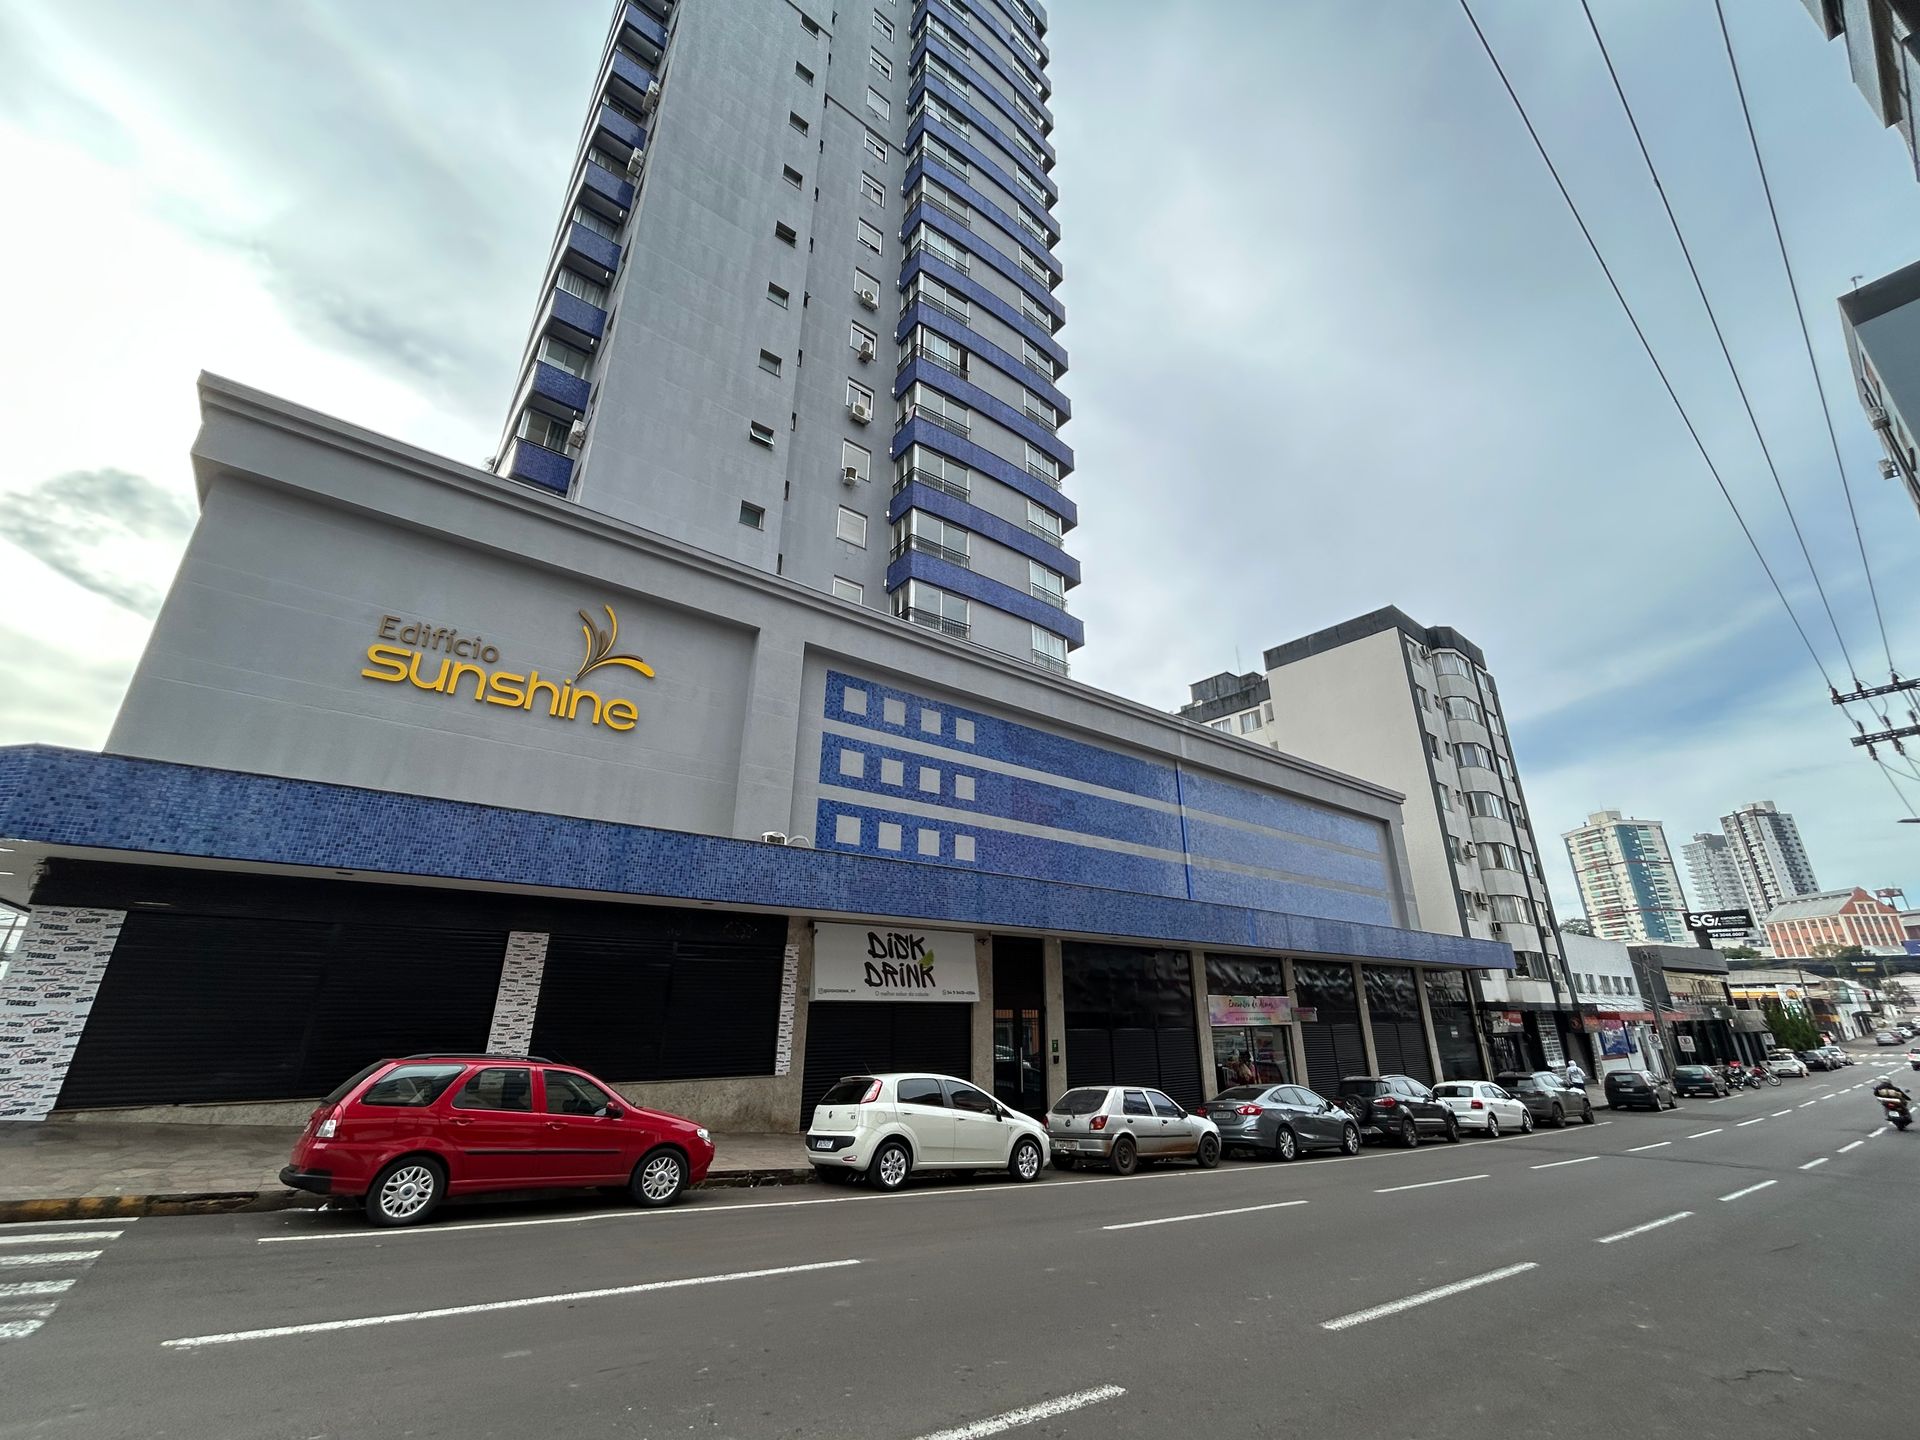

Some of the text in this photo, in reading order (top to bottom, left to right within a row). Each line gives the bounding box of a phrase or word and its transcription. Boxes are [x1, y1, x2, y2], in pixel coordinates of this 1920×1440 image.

[378, 614, 499, 663] Edifício
[39, 923, 69, 931] TORRES
[26, 952, 57, 960] TORRES
[5, 999, 38, 1007] TORRES
[19, 1057, 48, 1065] CHOPP
